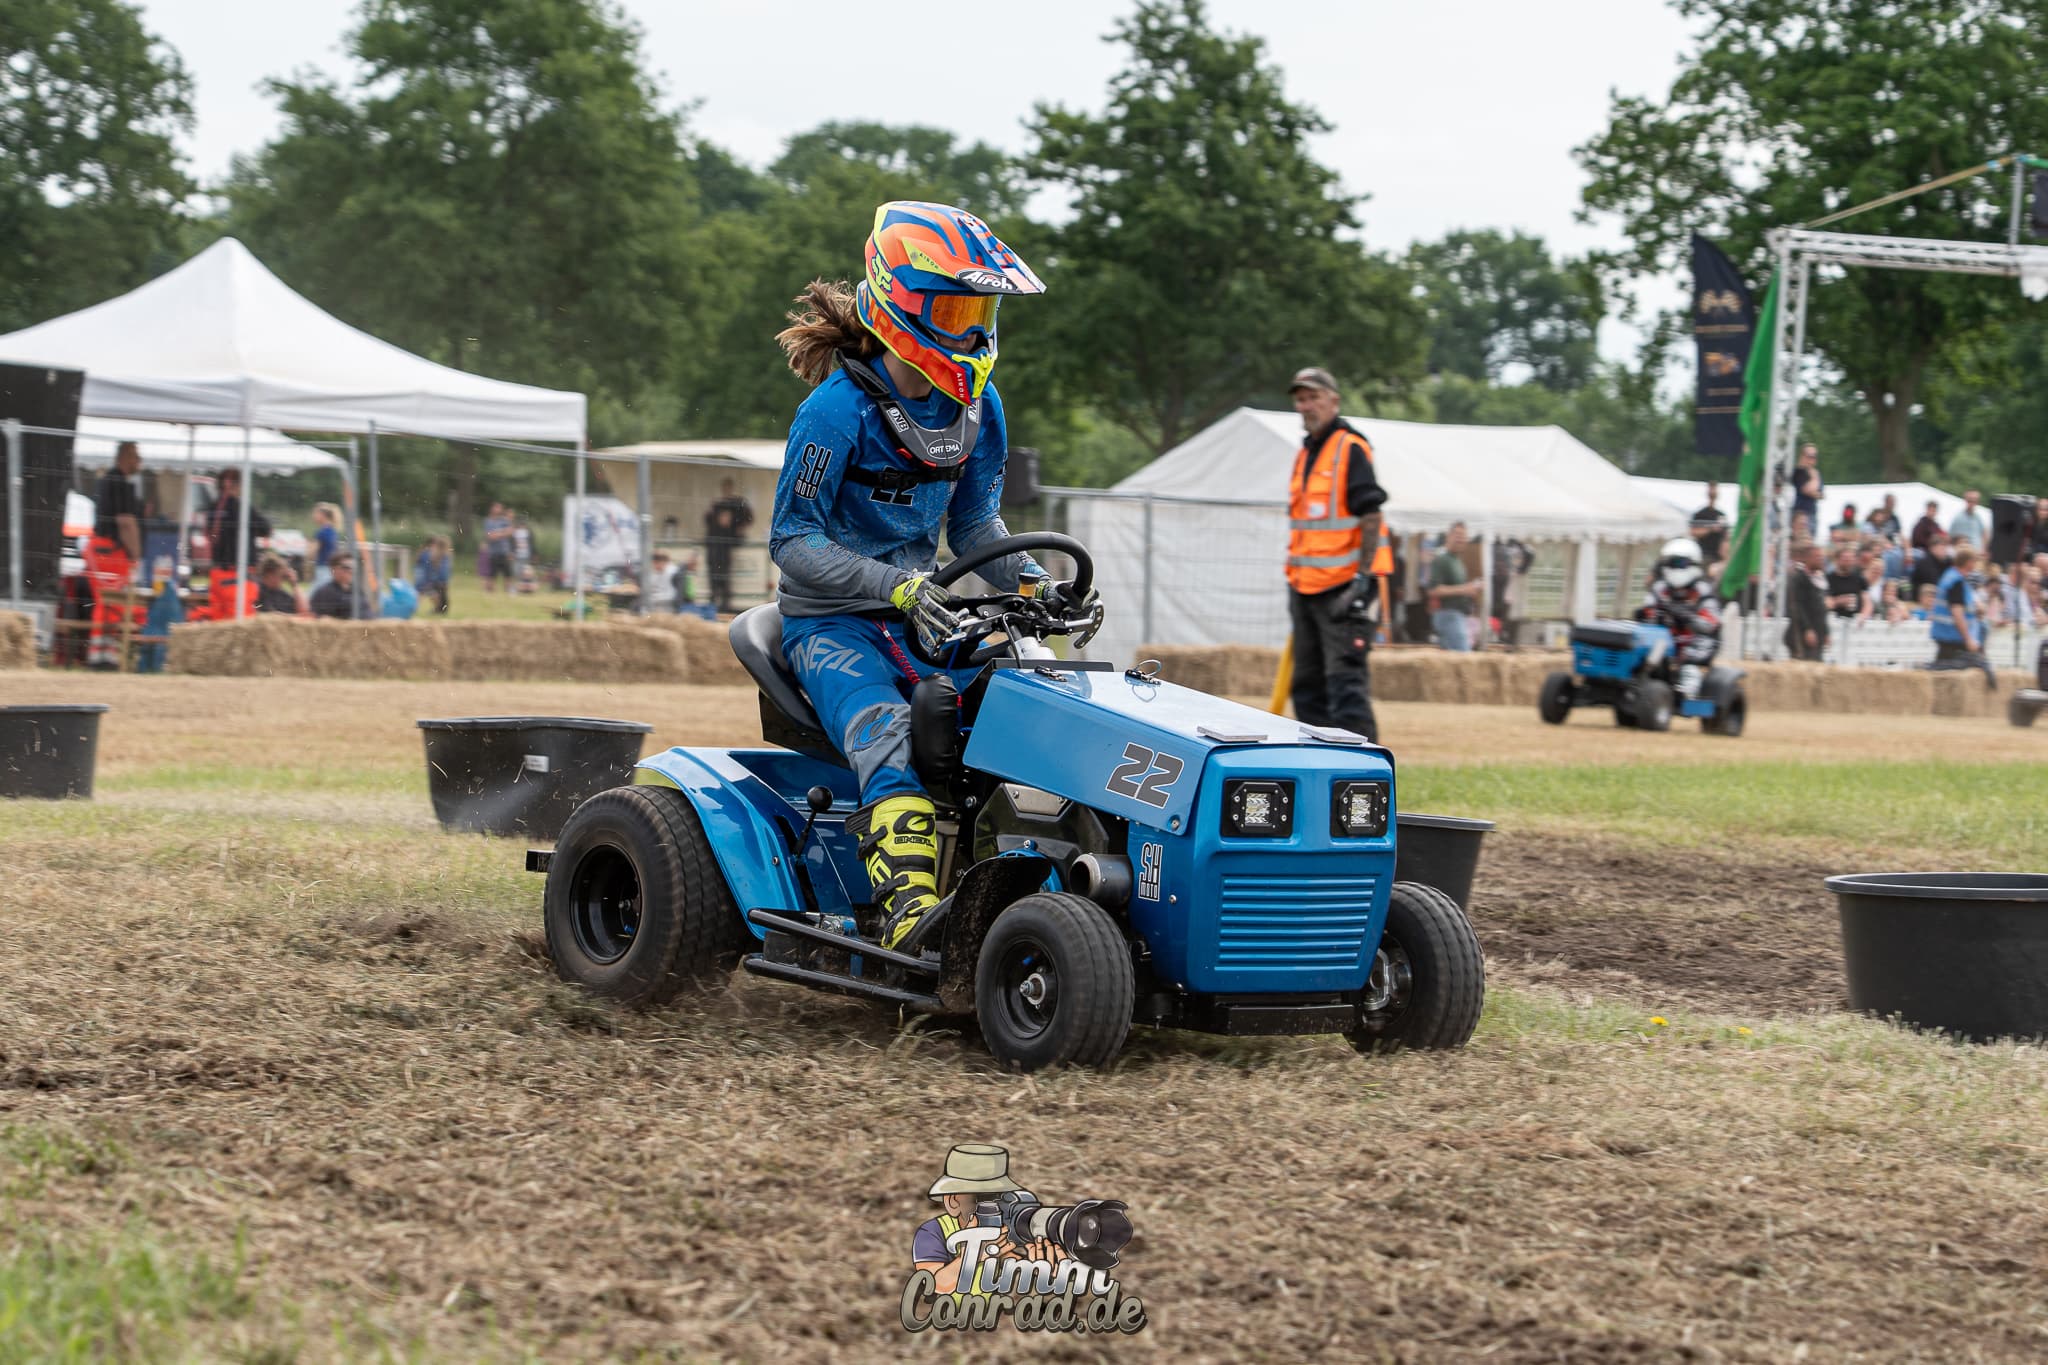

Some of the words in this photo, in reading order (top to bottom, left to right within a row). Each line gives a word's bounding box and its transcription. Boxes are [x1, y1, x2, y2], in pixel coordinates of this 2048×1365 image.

[963, 271, 1013, 291] Airoh
[929, 443, 960, 455] ORTEMA
[798, 442, 832, 486] SH
[793, 479, 820, 500] MOTO
[1105, 741, 1184, 809] 22
[1139, 842, 1163, 883] SH
[1138, 881, 1160, 902] MOTO
